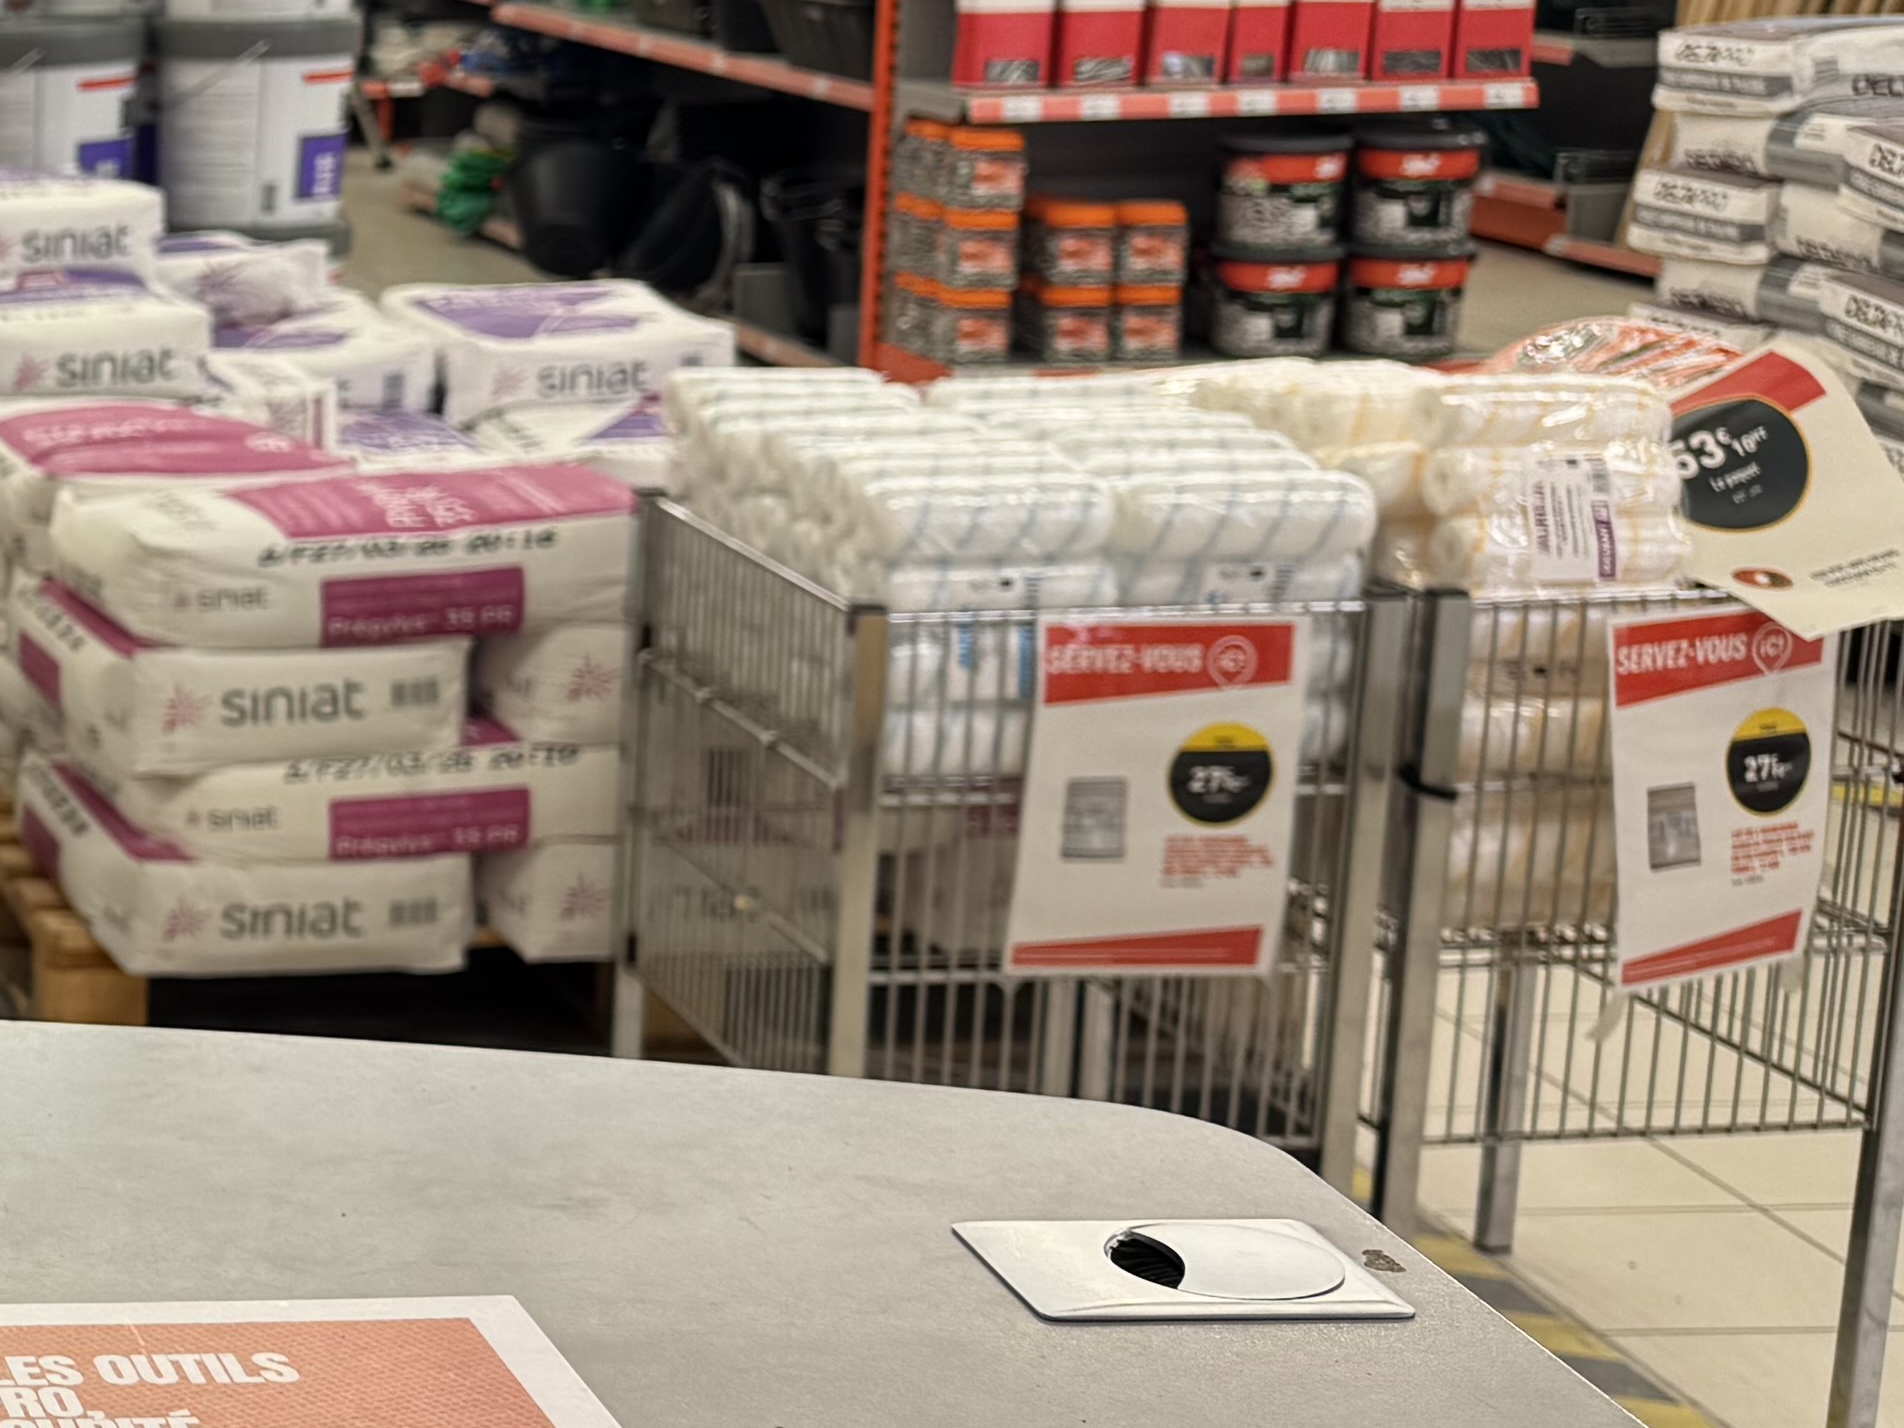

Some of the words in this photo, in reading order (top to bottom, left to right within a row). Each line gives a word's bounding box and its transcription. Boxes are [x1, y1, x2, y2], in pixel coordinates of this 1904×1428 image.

[21, 223, 132, 265] siniat
[1615, 629, 1747, 675] SERVEZ-VOUS
[220, 678, 367, 724] siniat
[220, 899, 364, 940] siniat
[92, 1351, 300, 1384] OUTILS
